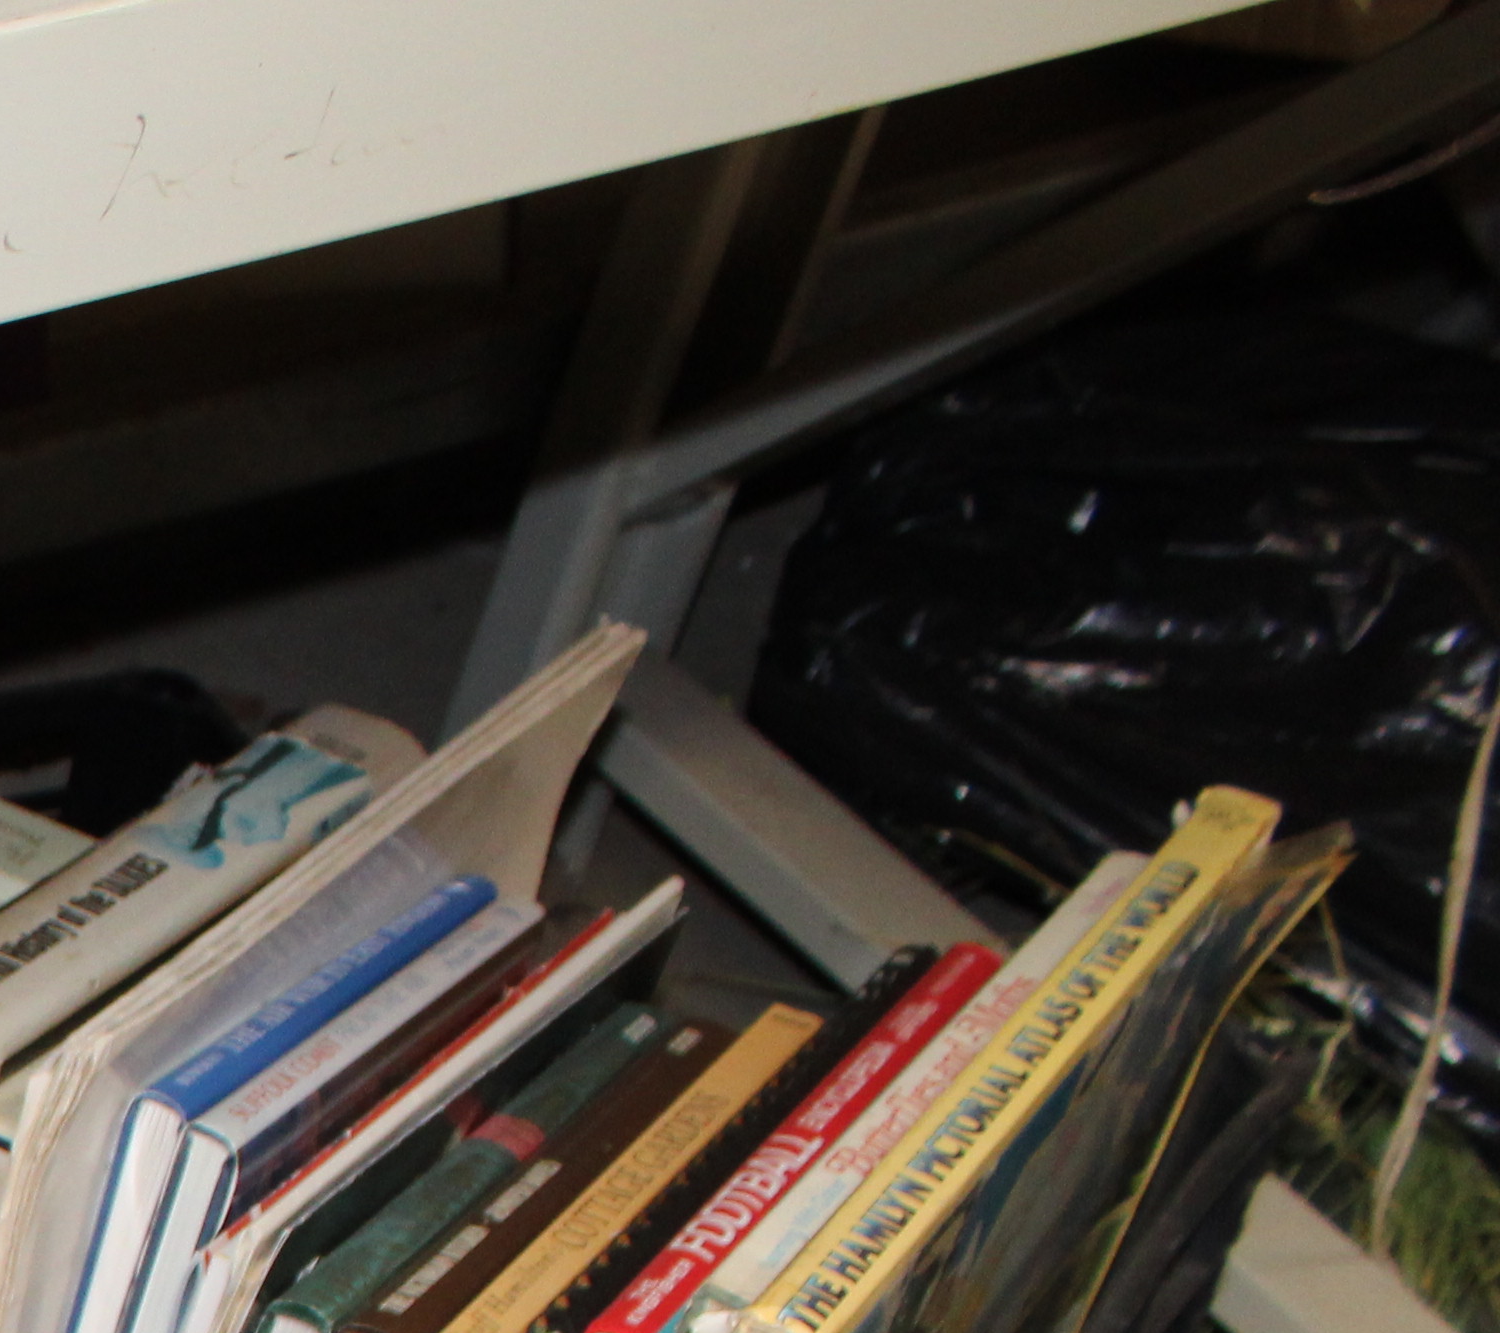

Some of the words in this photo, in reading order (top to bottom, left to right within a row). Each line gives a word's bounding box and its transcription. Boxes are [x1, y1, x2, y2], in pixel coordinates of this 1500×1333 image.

[686, 1131, 822, 1266] FOOTBALL
[819, 1168, 938, 1285] HAMLYN
[906, 1055, 1035, 1183] PICTORIAL
[1004, 989, 1089, 1069] ATLAS
[1116, 853, 1203, 938] WORLD
